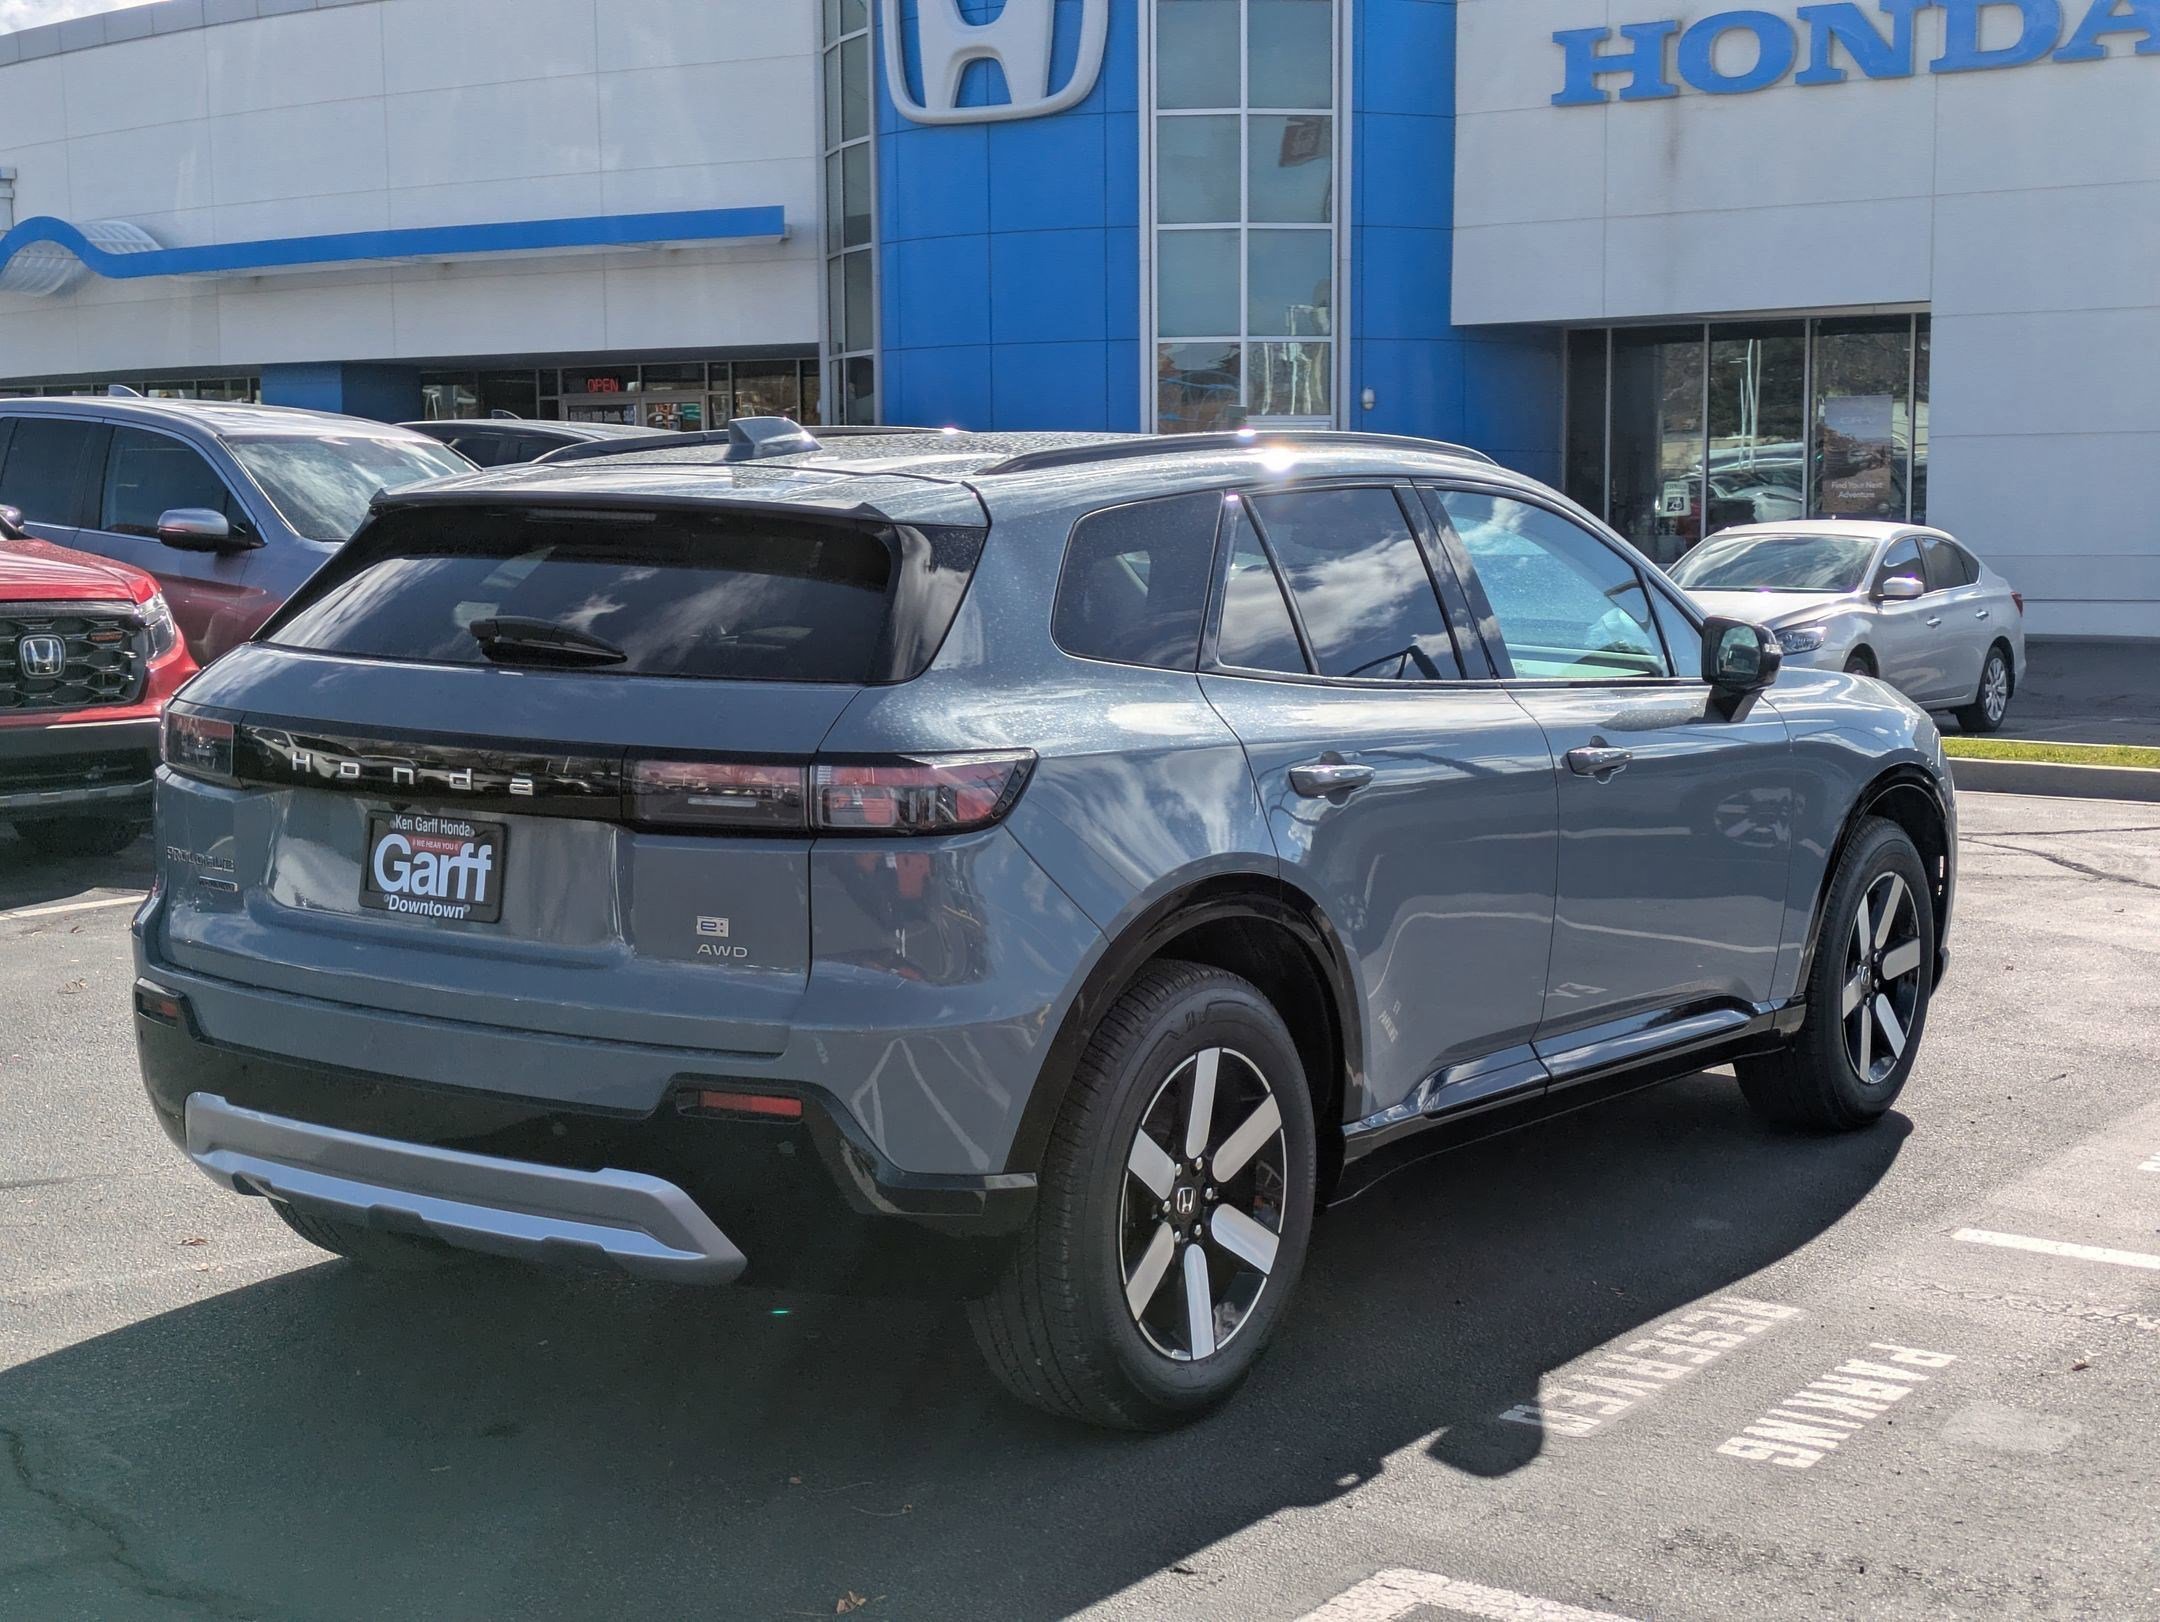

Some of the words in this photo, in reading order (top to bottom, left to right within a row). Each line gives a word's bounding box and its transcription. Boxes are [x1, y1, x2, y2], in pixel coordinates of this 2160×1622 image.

[1551, 0, 2160, 106] HONDA
[587, 378, 620, 393] OPEN
[1832, 481, 1847, 489] Find
[1849, 481, 1865, 489] Your
[1866, 480, 1884, 489] Next
[1838, 490, 1876, 498] Adventure
[291, 751, 535, 796] Honda
[395, 814, 413, 831] Ken
[415, 816, 438, 834] Garff
[440, 819, 471, 837] Honda
[416, 839, 425, 847] WE
[426, 840, 441, 849] HEAR
[442, 841, 454, 850] YOU
[374, 833, 492, 902] Garff
[388, 894, 465, 919] Downtown
[697, 943, 748, 958] AWD
[1500, 1297, 1802, 1438] RESERVED
[1714, 1342, 1959, 1469] PARKING
